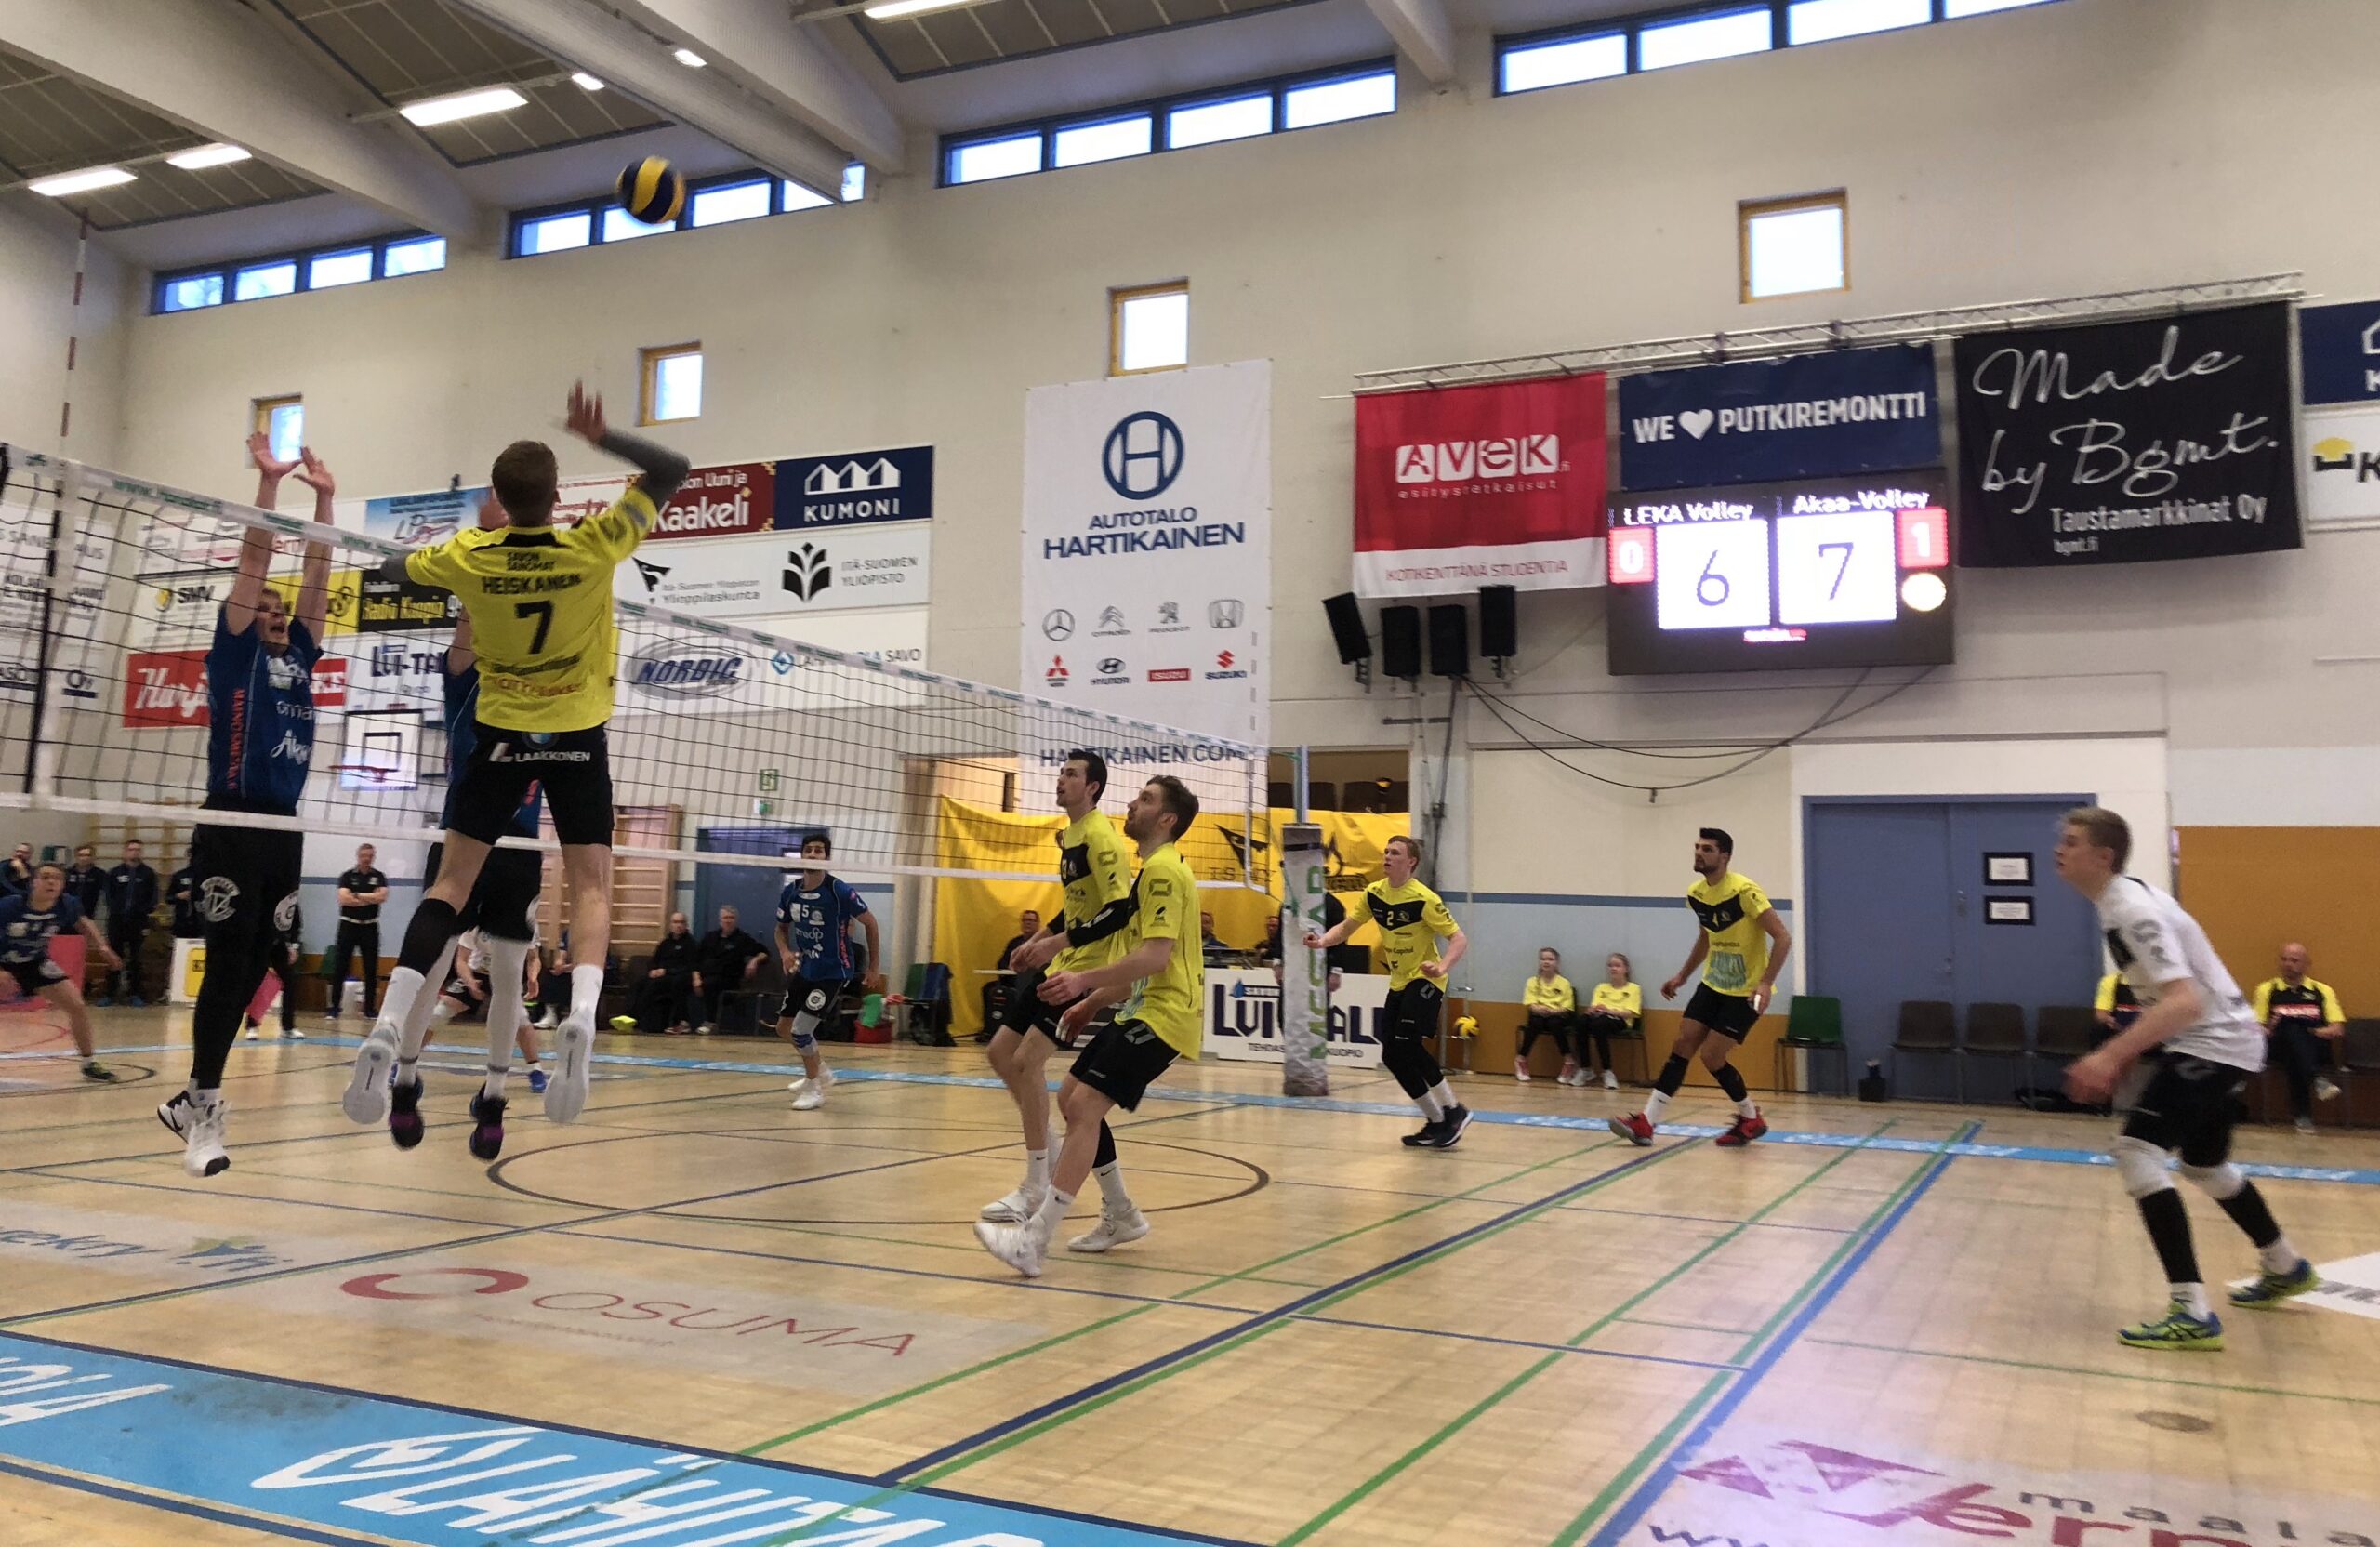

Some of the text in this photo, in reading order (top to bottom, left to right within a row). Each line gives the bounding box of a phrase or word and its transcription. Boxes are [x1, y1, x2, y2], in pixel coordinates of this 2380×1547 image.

[1973, 325, 2244, 410] Made
[1633, 391, 1927, 443] WE PUTKIREMONTTI
[1982, 429, 2047, 515] by
[652, 494, 748, 533] Kaakeli
[804, 498, 900, 522] KUMONI
[1624, 500, 1754, 525] LEKA Volley
[1793, 488, 1930, 515] Akaa-Volley
[2049, 494, 2268, 533] Taustamarkkinat Oy
[1089, 507, 1197, 530] AUTOTALO
[1044, 522, 1246, 559] HARTIKAINEN
[1911, 522, 1931, 558] 1
[841, 557, 919, 571] ITÄ-SUOMEN
[1491, 560, 1568, 576] STUDENTIA
[1619, 540, 1644, 574] 0
[1818, 542, 1854, 601] 7
[482, 573, 581, 594] HEISKANEN
[841, 573, 905, 586] YLIOPISTO
[1696, 549, 1730, 606] 6
[515, 600, 554, 654] 7
[636, 657, 743, 683] NORDIC
[885, 649, 922, 662] SAVO
[515, 750, 590, 762] LAAKKONEN
[1386, 910, 1394, 926] 2
[531, 1292, 916, 1357] OSUMA
